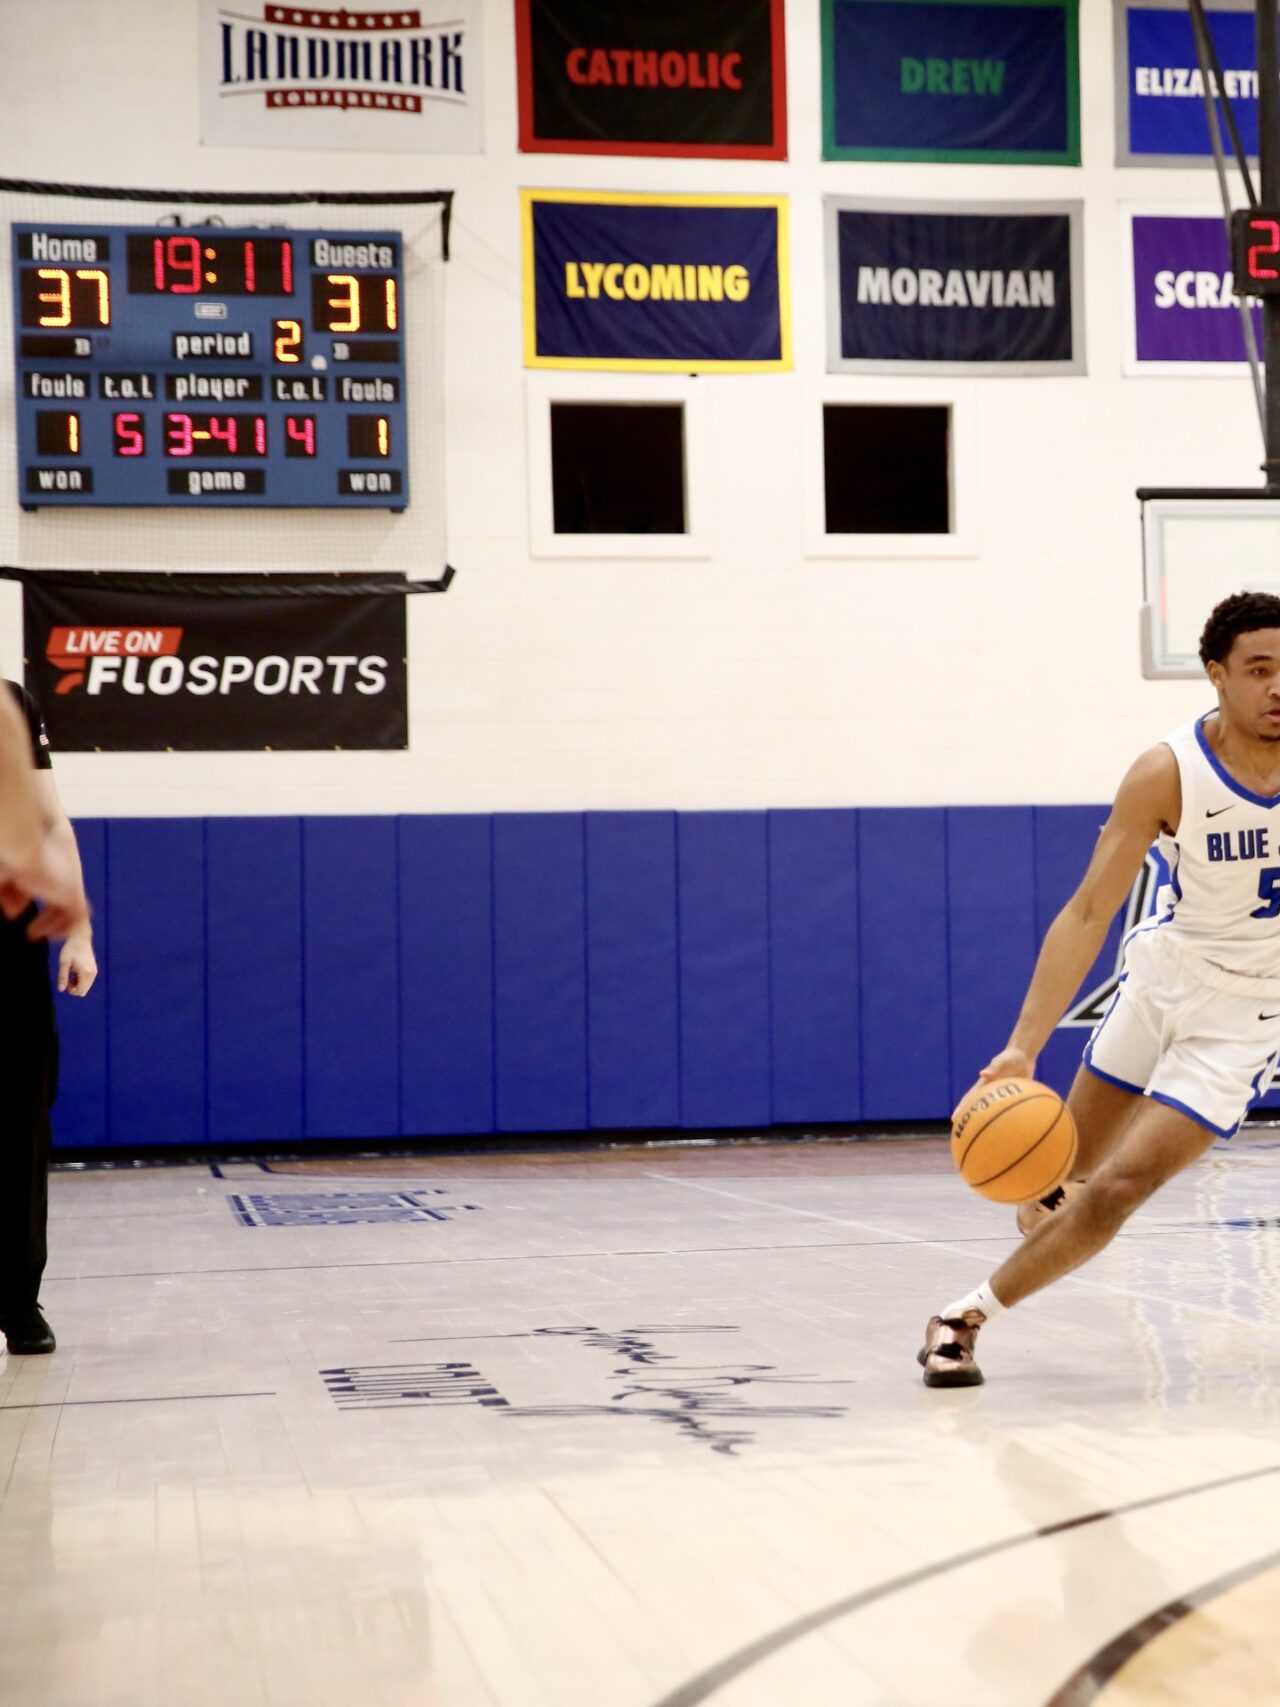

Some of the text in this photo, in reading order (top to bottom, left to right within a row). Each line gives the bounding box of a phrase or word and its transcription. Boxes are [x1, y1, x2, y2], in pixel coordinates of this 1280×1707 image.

[219, 22, 465, 95] LANDMARK
[566, 48, 743, 90] CATHOLIC
[901, 57, 1006, 96] DREW
[273, 91, 416, 110] CONFERENCE
[32, 233, 97, 262] Home
[153, 236, 293, 293] 19:11
[314, 238, 393, 267] Guests
[38, 269, 110, 327] 37
[566, 262, 750, 302] LYCOMING
[857, 266, 1055, 307] MORAVIAN
[328, 275, 397, 332] 31
[176, 332, 251, 360] period
[275, 320, 301, 363] 2
[31, 373, 85, 398] fouls
[176, 373, 249, 400] player
[343, 377, 394, 402] fouls
[68, 415, 79, 453] 1
[115, 414, 143, 455] 5
[287, 417, 315, 454] 4
[377, 418, 388, 455] 1
[39, 470, 82, 490] won
[188, 470, 246, 494] game
[350, 471, 392, 492] won
[65, 631, 162, 653] LIVE ON
[87, 655, 388, 695] FLOSPORTS
[1207, 828, 1269, 862] BLUE
[319, 1363, 510, 1411] COURT
